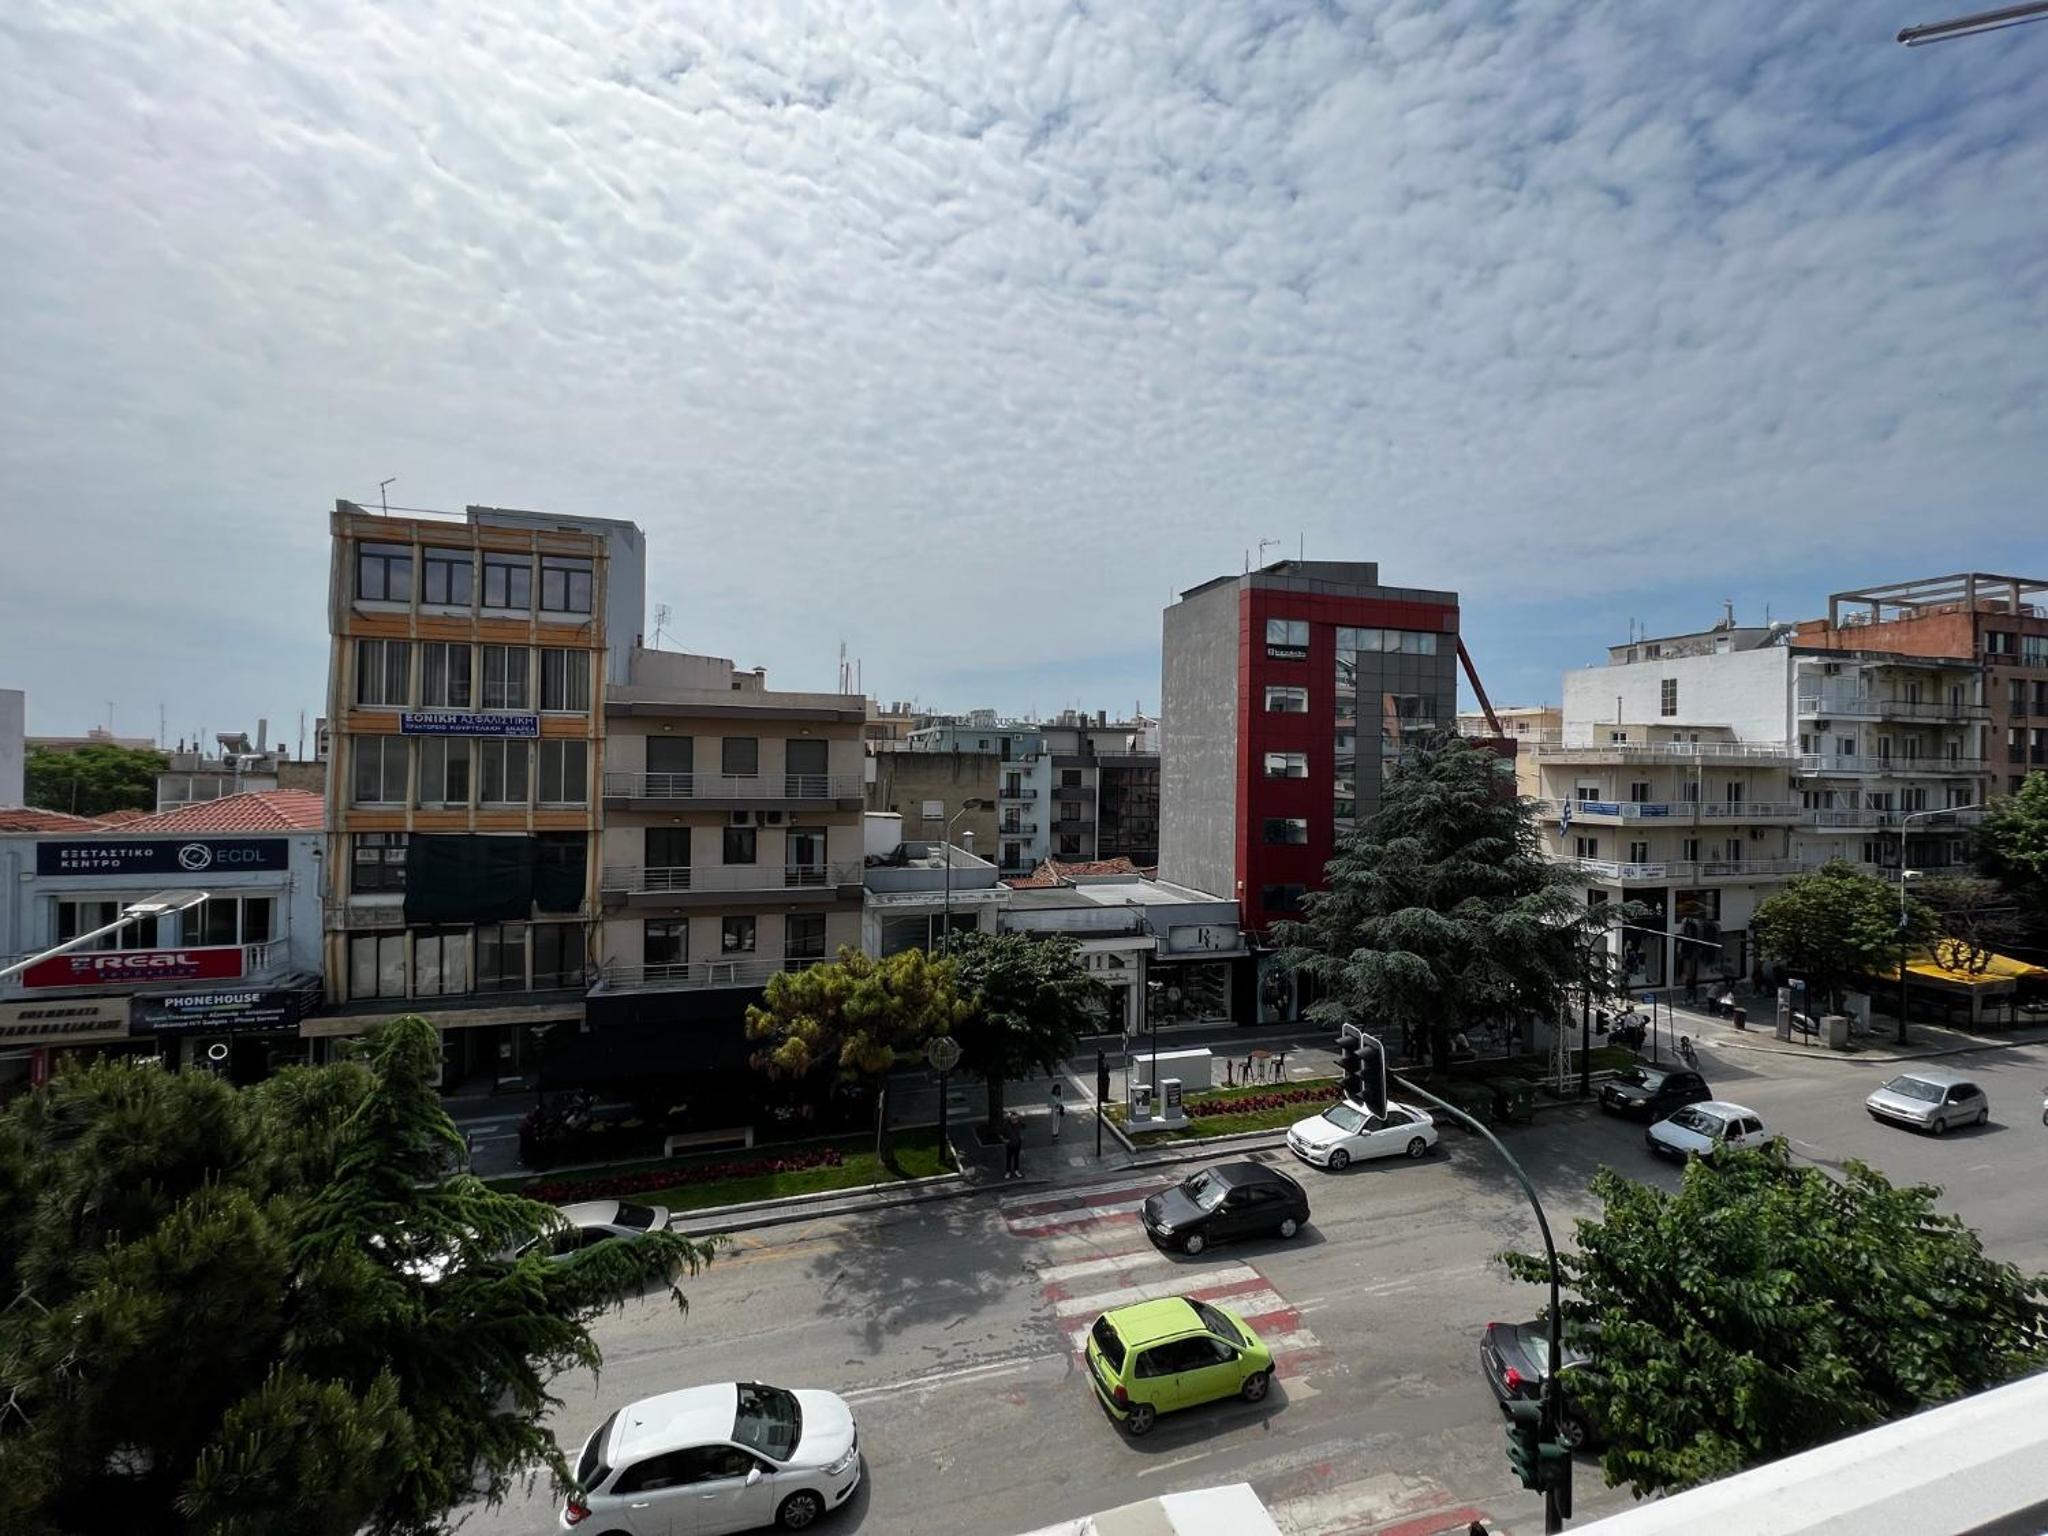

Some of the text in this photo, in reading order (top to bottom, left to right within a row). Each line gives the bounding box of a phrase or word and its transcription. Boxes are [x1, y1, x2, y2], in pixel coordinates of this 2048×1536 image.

[405, 713, 534, 725] ΕΘΝΙΚΗ ΑΣΦΑΛΙΣΤΙΚΗ
[61, 849, 154, 859] ΕΞΕΤΑΣΤΙΚΟ
[217, 849, 267, 863] ECDL
[61, 859, 121, 868] ΚΕΝΤΡΟ
[165, 993, 261, 1007] PHONEHOUSE
